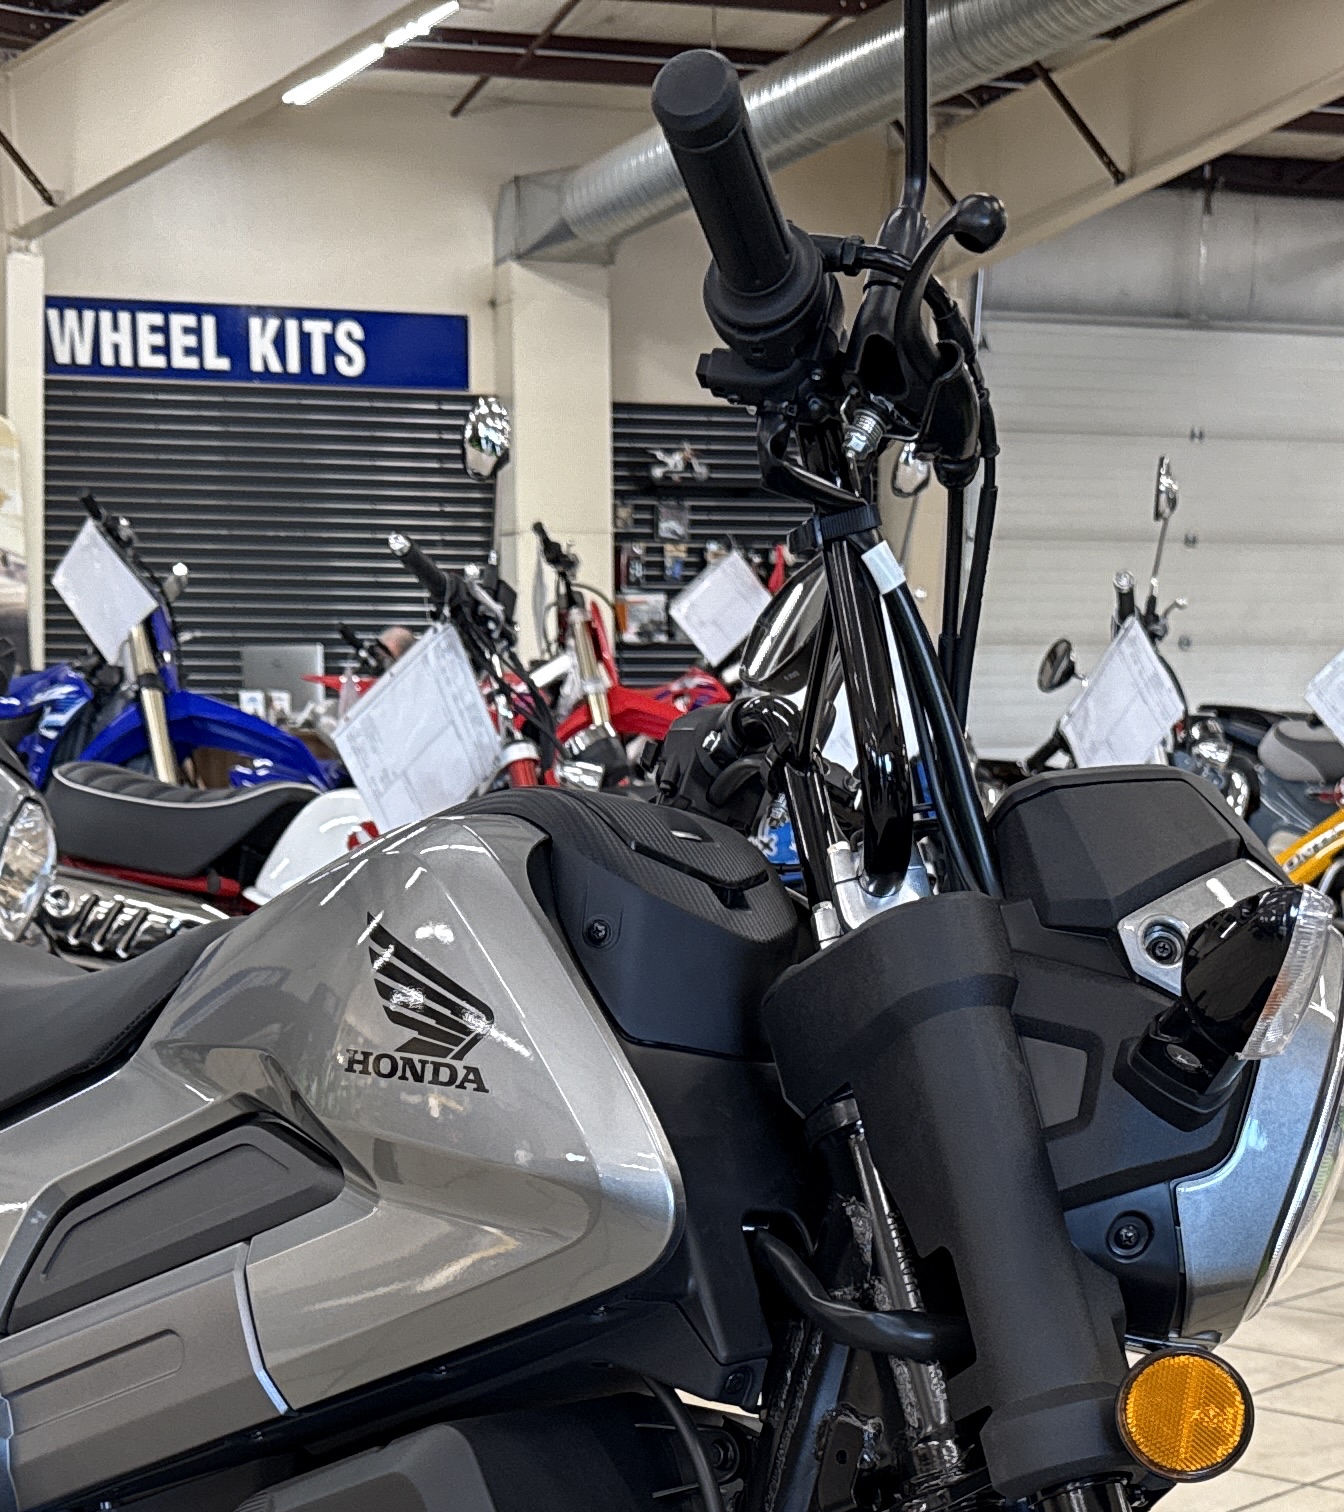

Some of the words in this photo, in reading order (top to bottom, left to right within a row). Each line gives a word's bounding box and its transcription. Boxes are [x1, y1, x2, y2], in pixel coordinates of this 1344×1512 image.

[47, 307, 231, 372] WHEEL
[249, 316, 366, 377] KITS
[344, 1048, 490, 1094] HONDA
